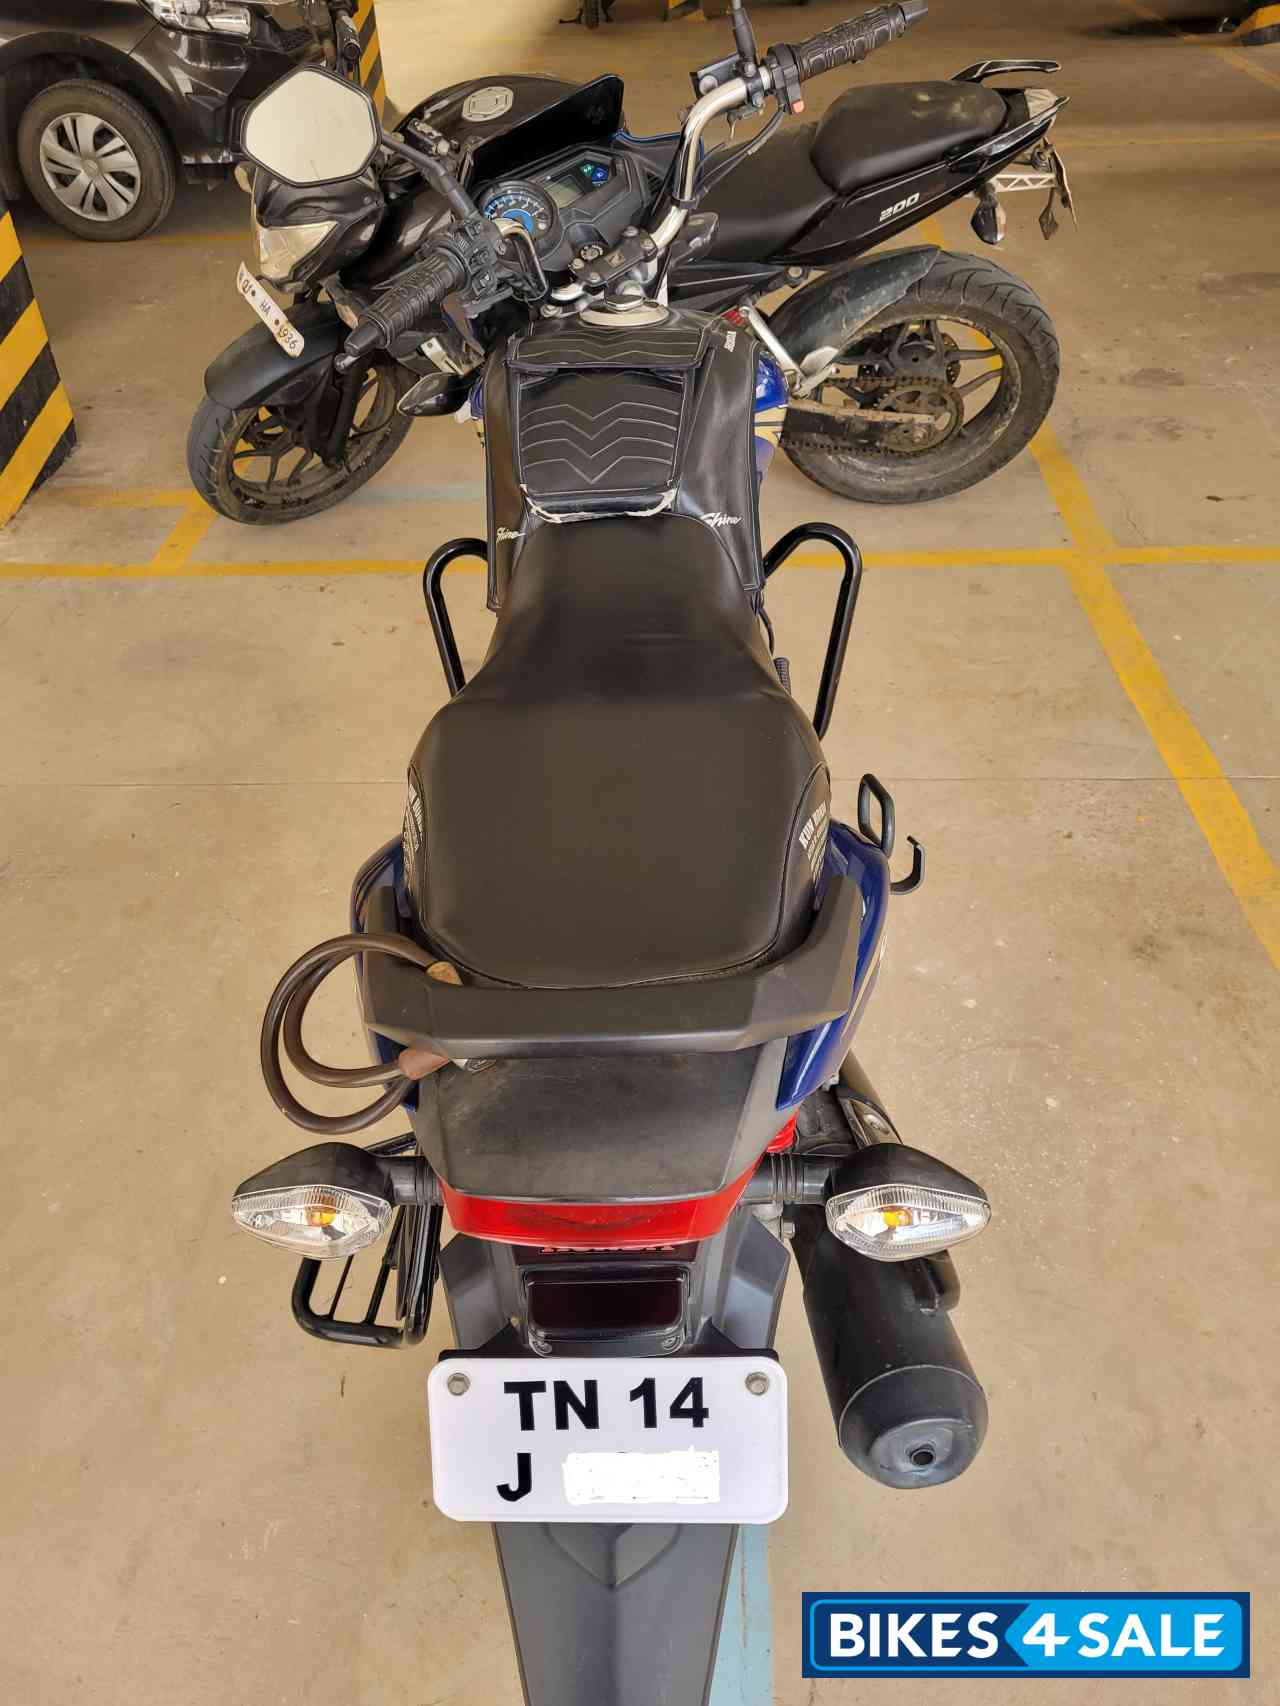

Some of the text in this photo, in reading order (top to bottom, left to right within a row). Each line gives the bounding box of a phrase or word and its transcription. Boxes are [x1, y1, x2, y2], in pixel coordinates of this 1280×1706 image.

[879, 192, 920, 221] 200
[504, 1377, 710, 1431] TN 14
[496, 1453, 533, 1502] J
